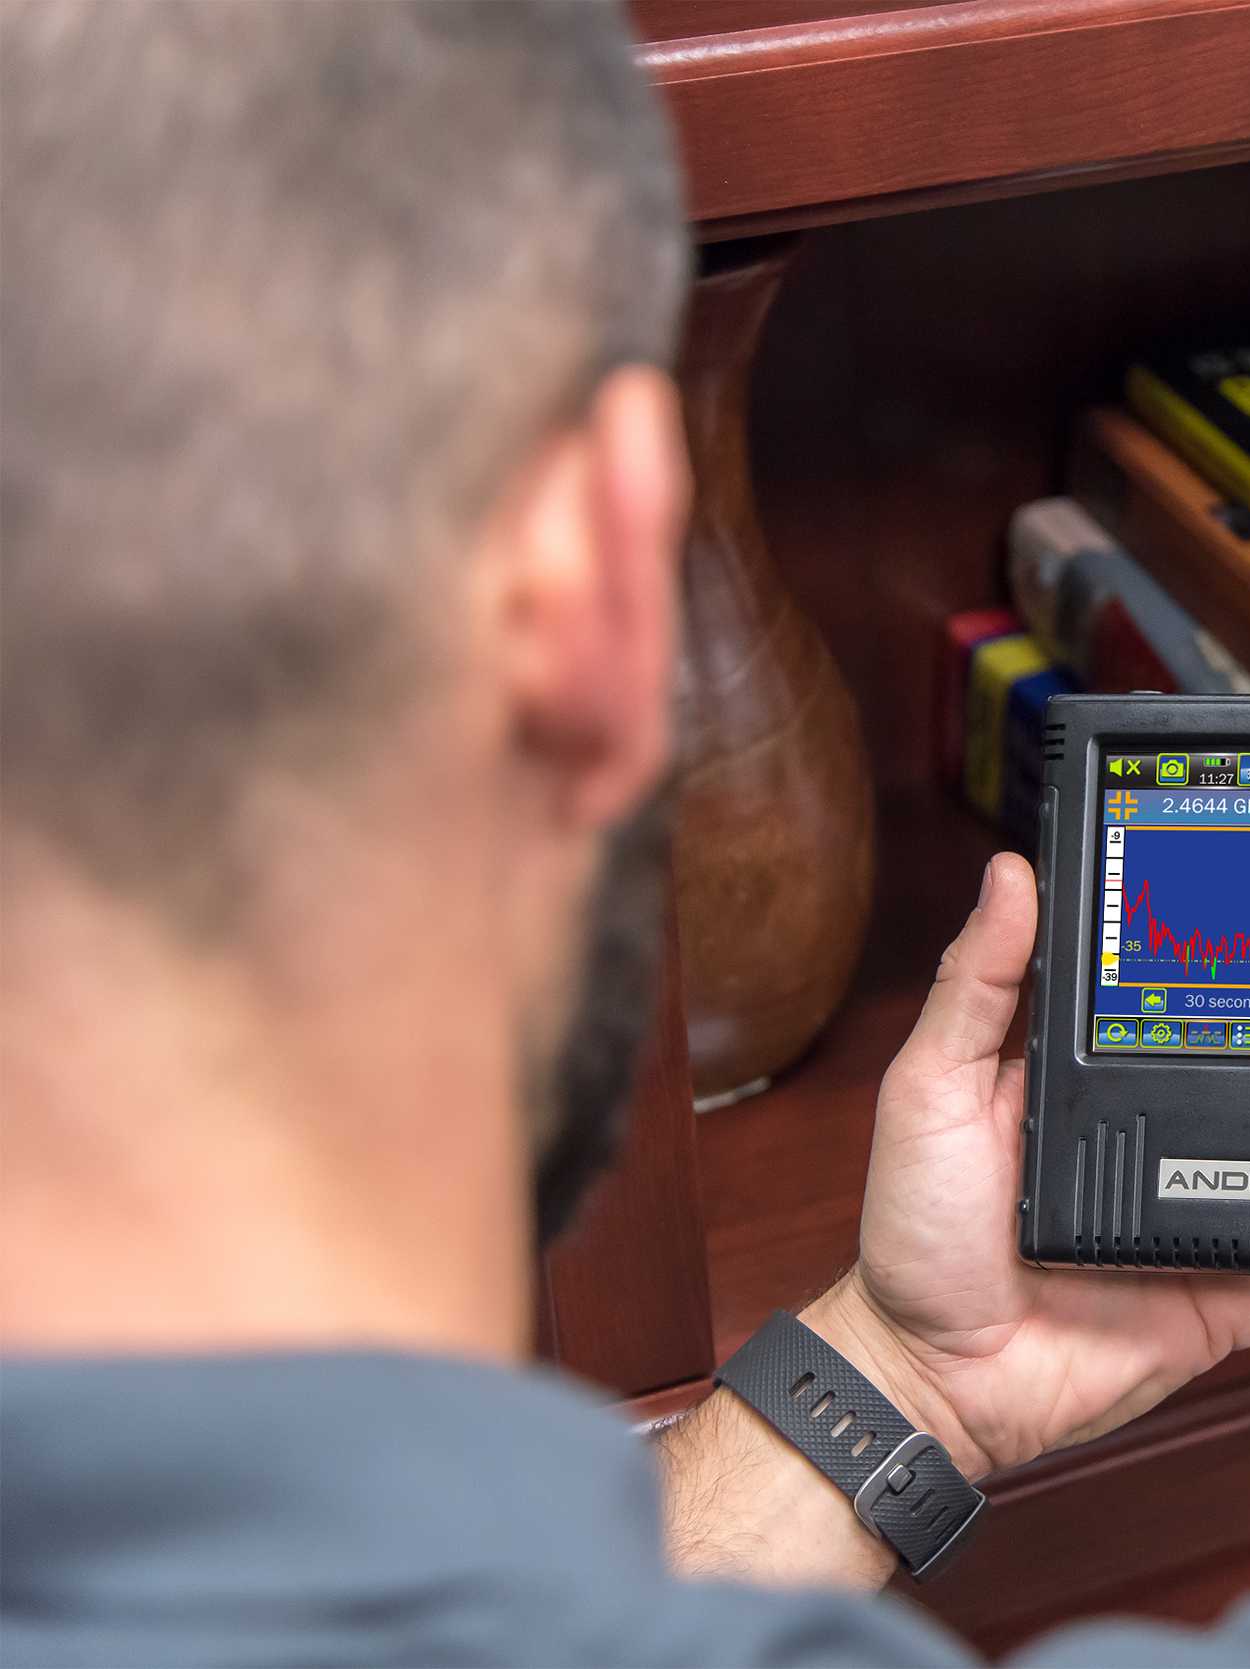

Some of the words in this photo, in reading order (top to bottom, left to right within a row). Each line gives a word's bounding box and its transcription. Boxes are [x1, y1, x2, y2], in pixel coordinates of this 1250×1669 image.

[1200, 773, 1233, 785] 11:27
[1162, 798, 1228, 815] 2.4644
[1110, 831, 1121, 841] -9
[1122, 940, 1142, 952] -35
[1102, 972, 1118, 982] -39
[1184, 994, 1205, 1008] 30
